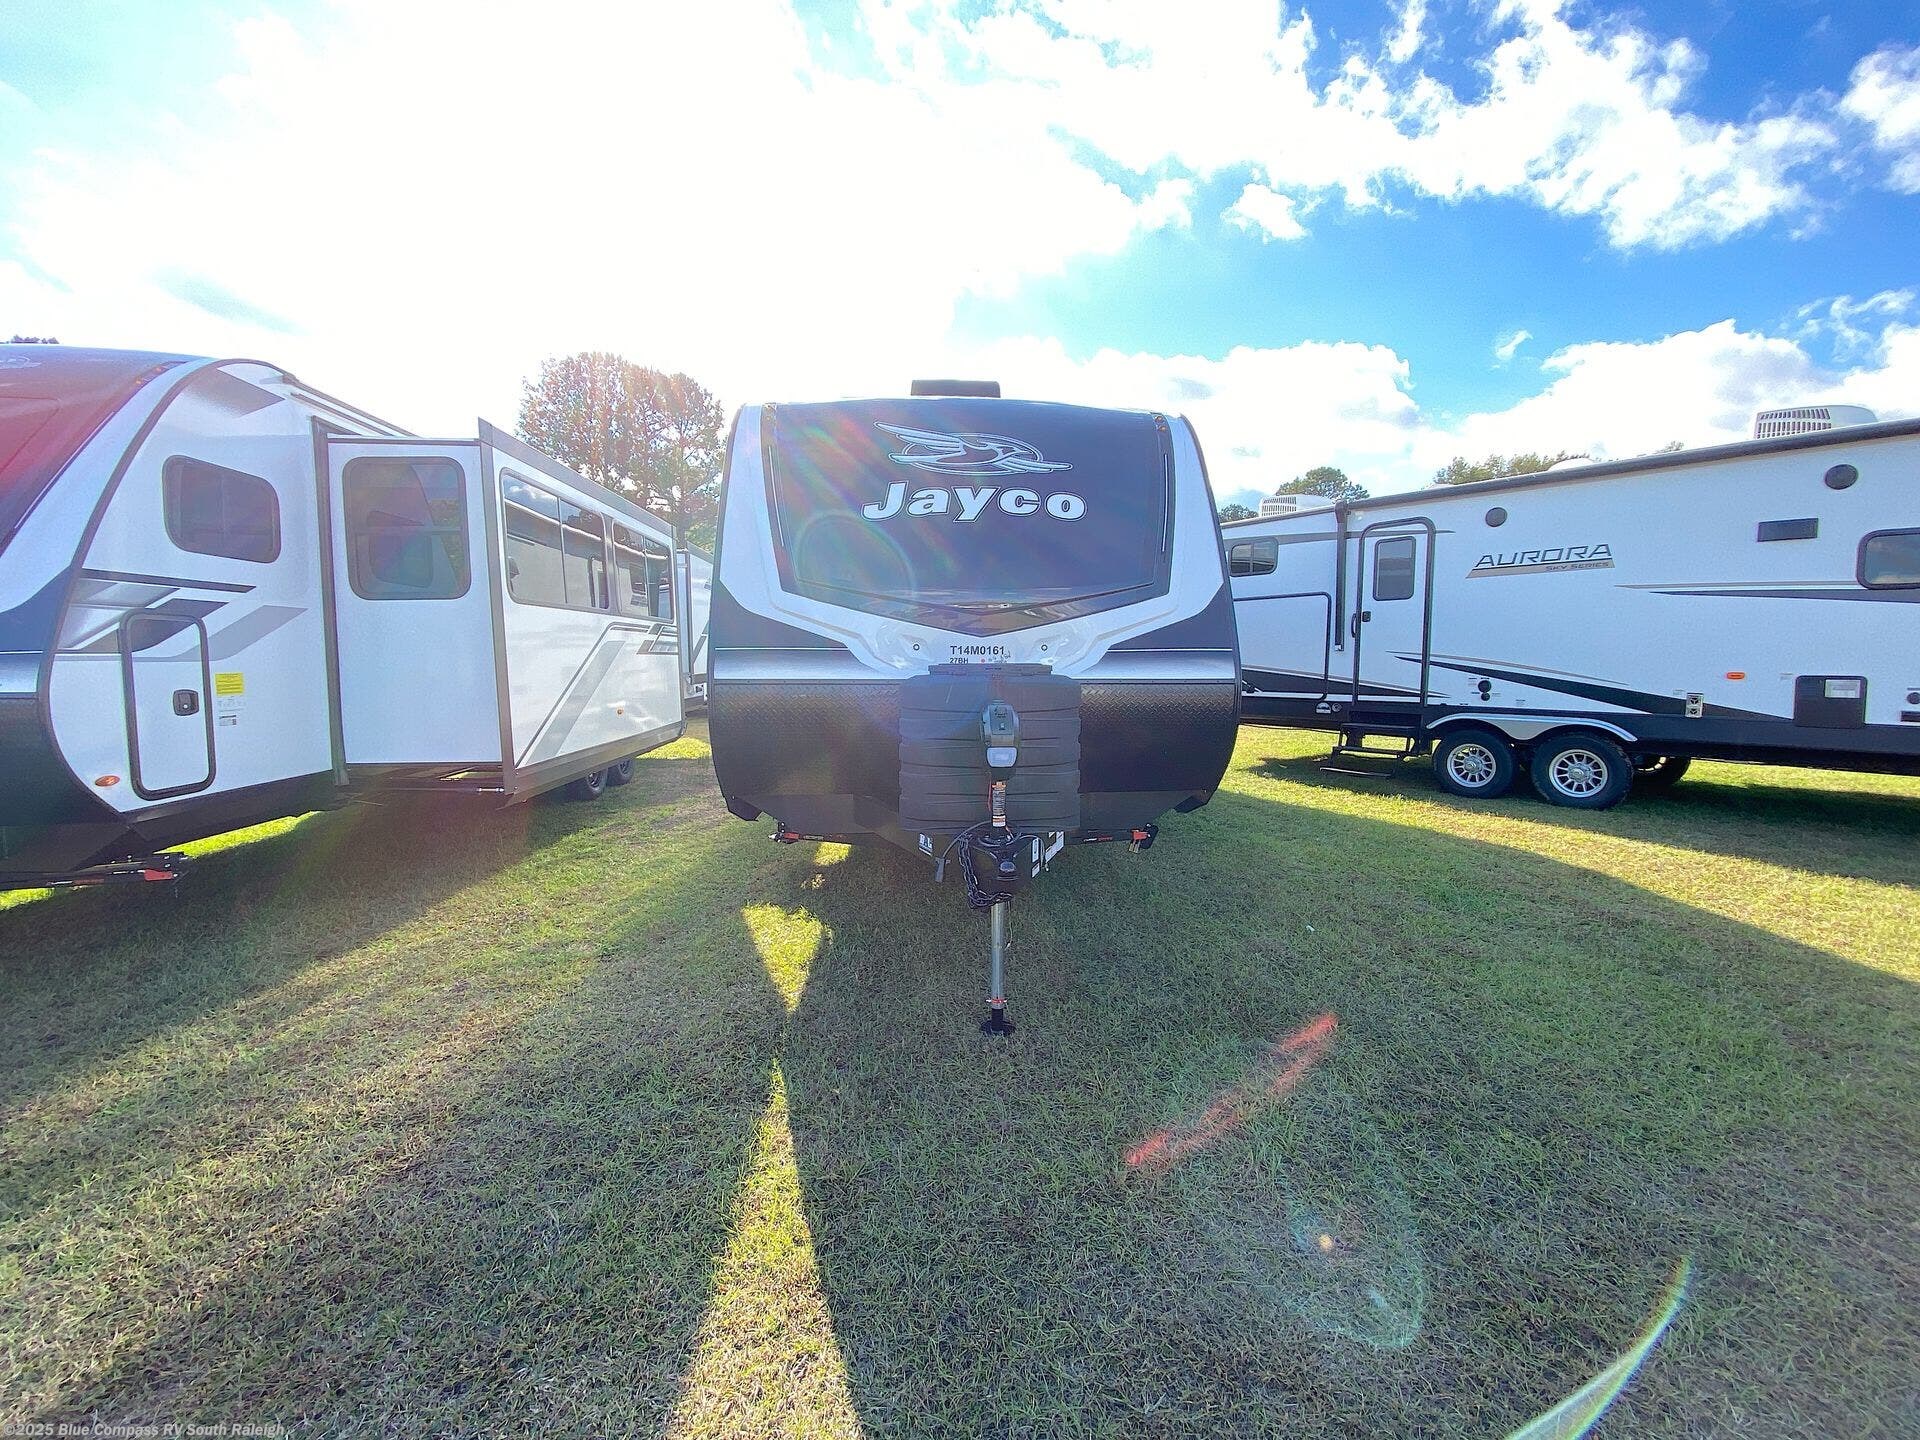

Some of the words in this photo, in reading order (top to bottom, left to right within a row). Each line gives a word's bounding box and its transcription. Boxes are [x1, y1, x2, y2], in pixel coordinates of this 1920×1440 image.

[861, 480, 1088, 522] Jayco
[1474, 544, 1612, 568] AURORA
[950, 645, 1004, 655] T14M0161
